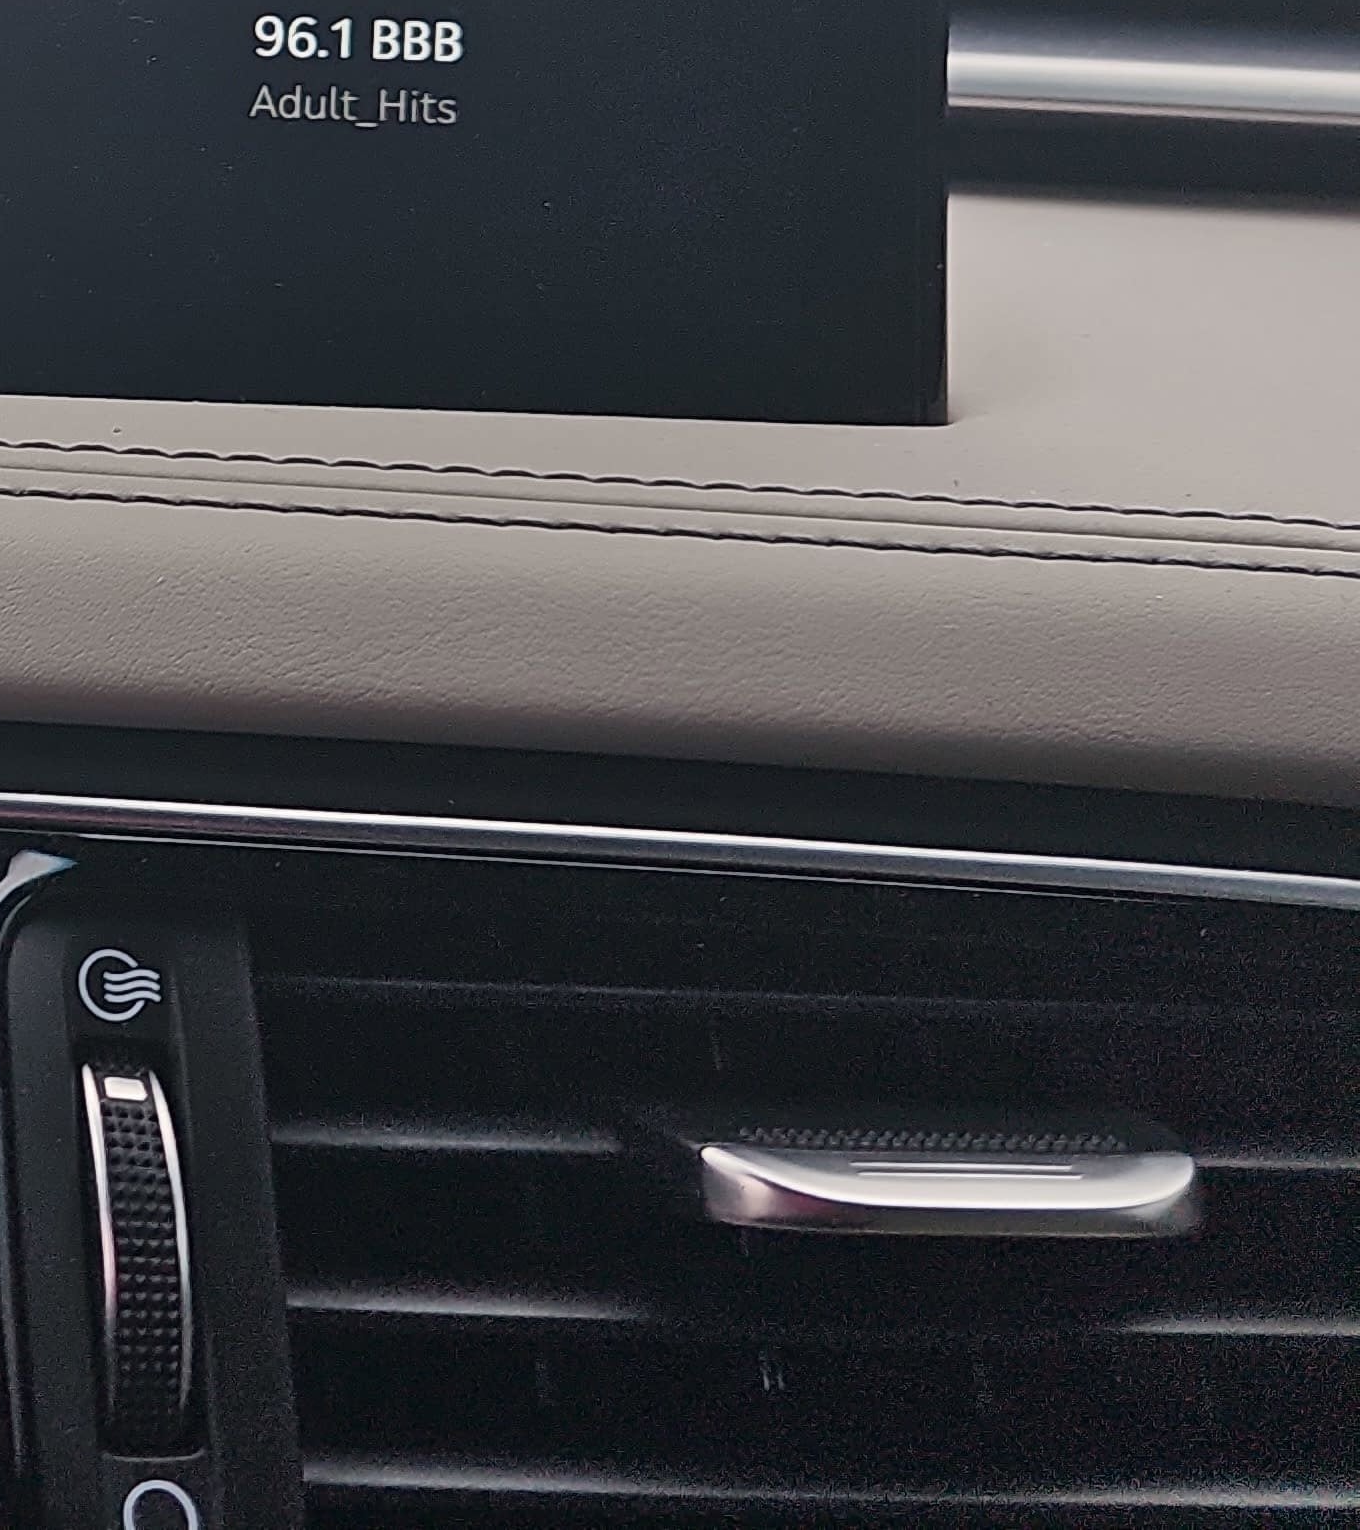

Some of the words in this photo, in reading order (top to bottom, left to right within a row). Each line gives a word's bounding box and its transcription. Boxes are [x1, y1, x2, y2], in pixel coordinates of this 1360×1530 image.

[254, 15, 353, 59] 96.1
[372, 19, 464, 62] BBB
[249, 84, 457, 128] Adult_Hits
